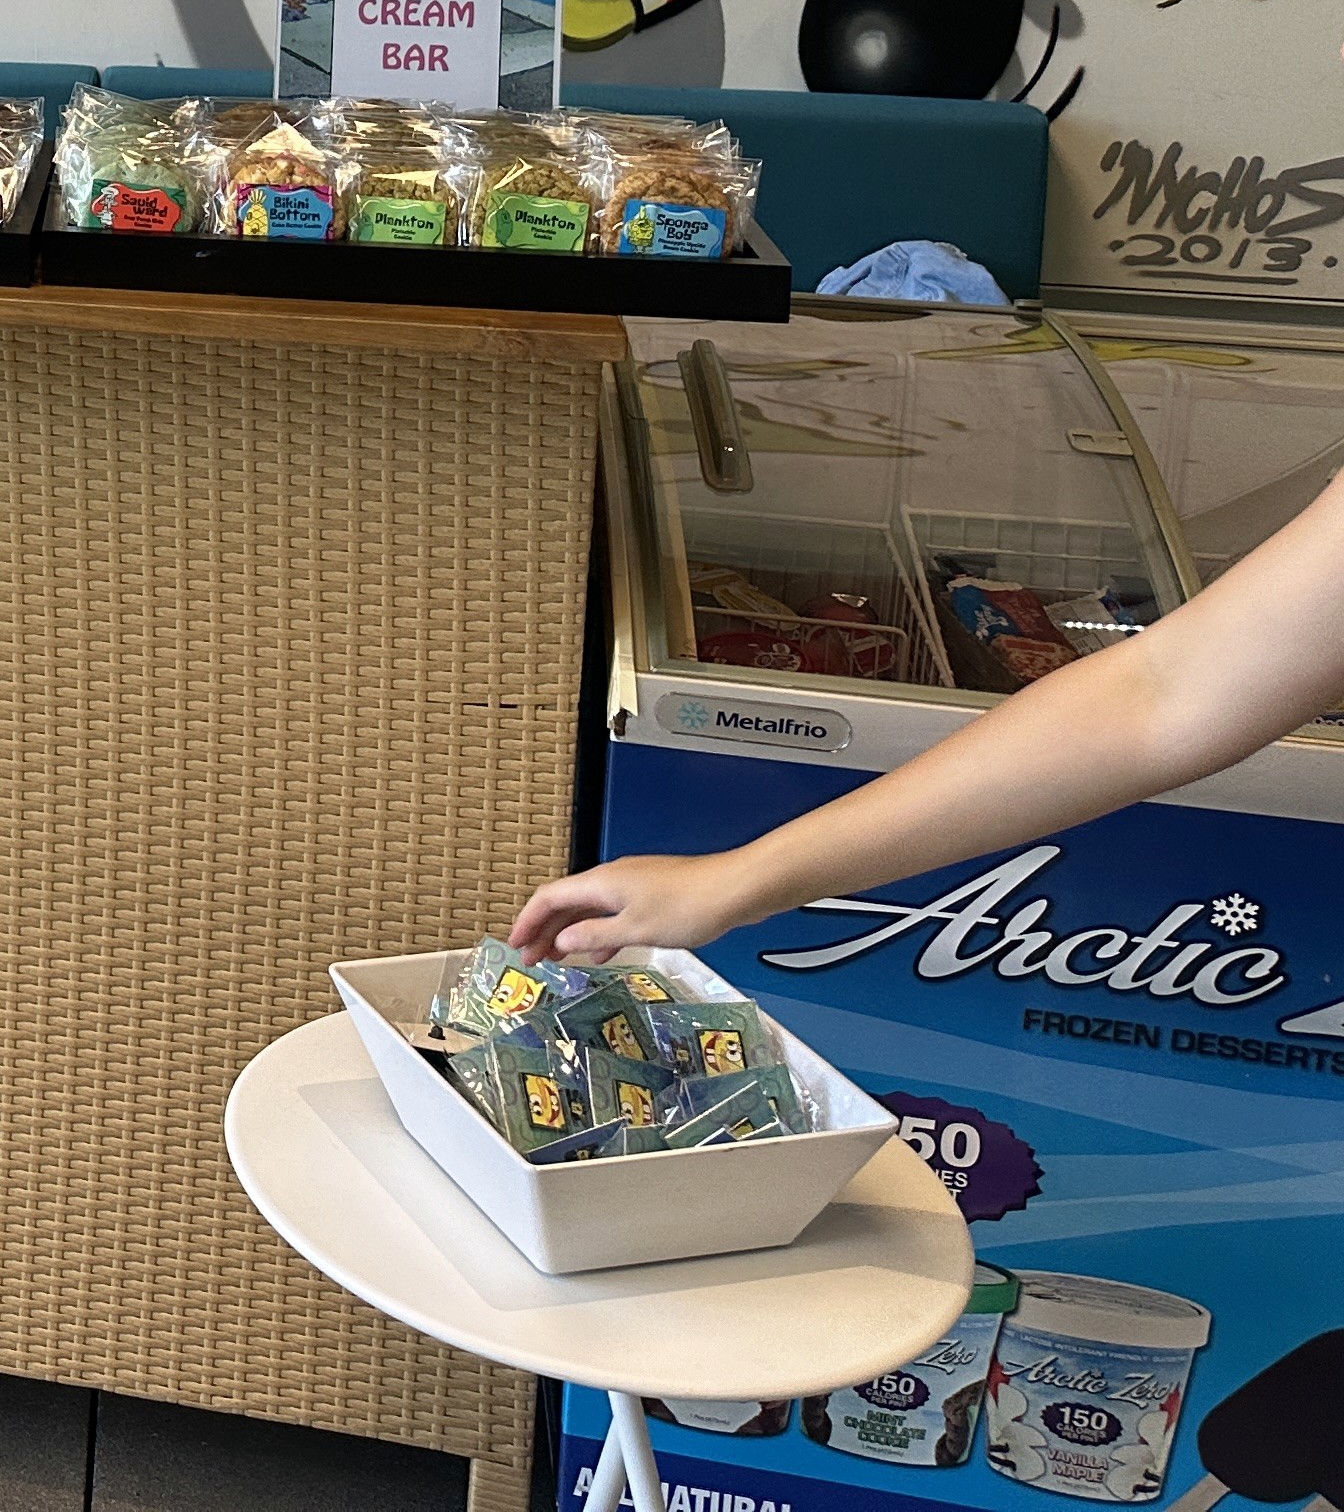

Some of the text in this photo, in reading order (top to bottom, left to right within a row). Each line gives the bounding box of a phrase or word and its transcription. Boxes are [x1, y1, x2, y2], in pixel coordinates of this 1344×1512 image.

[382, 42, 450, 72] BAR
[120, 193, 158, 207] Squid
[273, 196, 310, 209] Bikini
[269, 208, 321, 221] Bottom
[374, 212, 434, 230] Plankton
[514, 209, 576, 231] Plankton
[656, 213, 709, 234] Sponge
[666, 226, 692, 241] Bob
[715, 710, 828, 739] Metalfrio
[762, 845, 1285, 1004] Arctic
[1023, 1007, 1161, 1049] FROZEN
[898, 1115, 981, 1169] 50
[913, 1339, 980, 1375] Zero
[872, 1373, 915, 1396] 150
[1001, 1354, 1180, 1410] Arctic Zero
[865, 1388, 914, 1403] CALORIES
[843, 1415, 927, 1441] CHOCOLATE
[866, 1409, 907, 1427] MINT
[1059, 1406, 1108, 1431] 150
[857, 1429, 910, 1450] COOKIE
[1056, 1422, 1107, 1439] CALORIES
[1047, 1448, 1109, 1471] VANILLA
[1052, 1461, 1106, 1483] MAPLE
